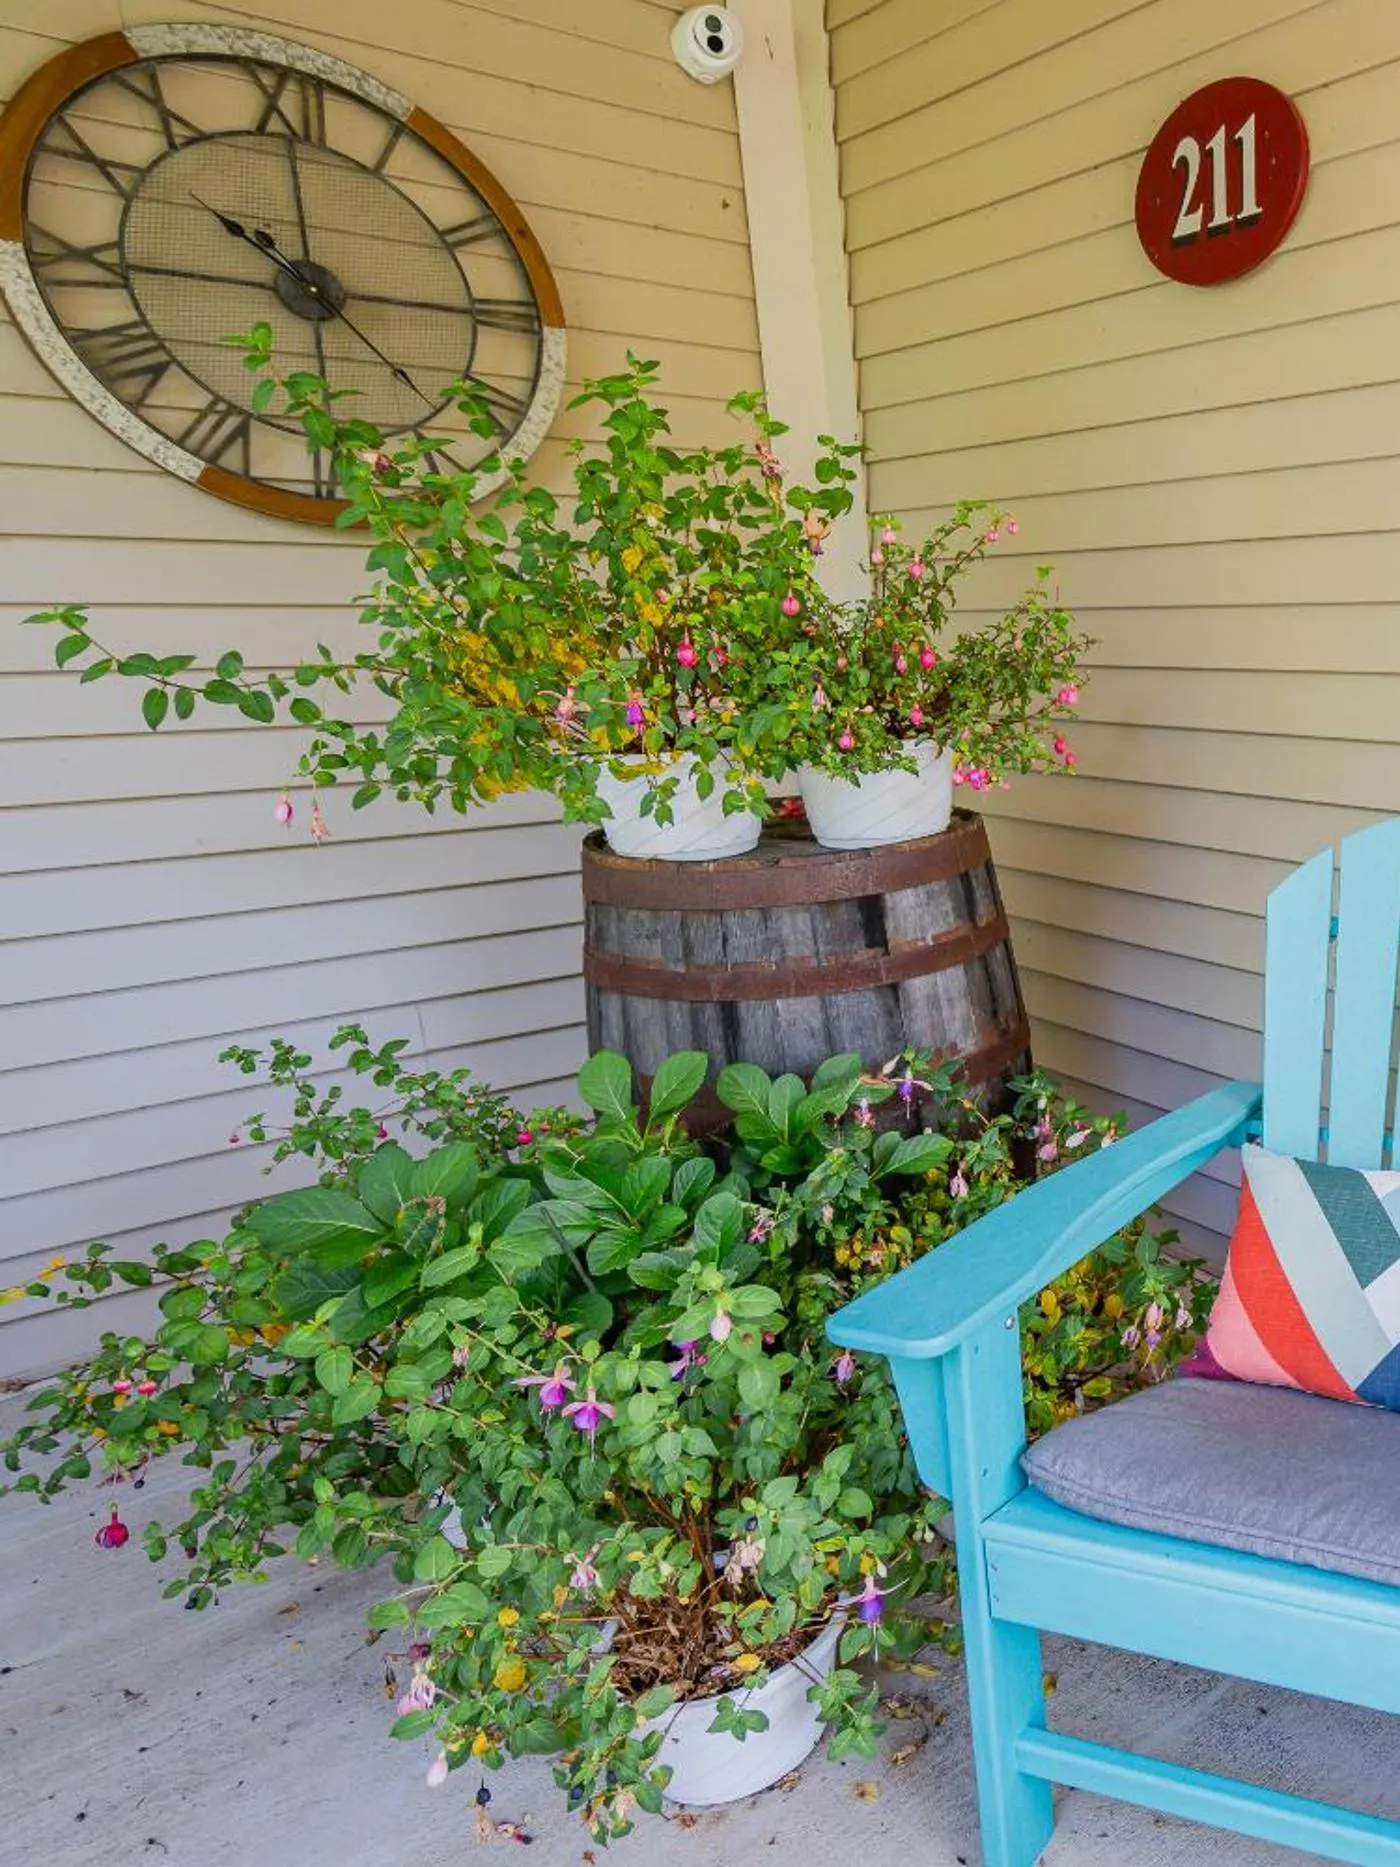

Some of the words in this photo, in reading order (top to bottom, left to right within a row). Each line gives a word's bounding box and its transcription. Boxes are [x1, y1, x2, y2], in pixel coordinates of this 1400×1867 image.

[241, 63, 327, 148] XII
[35, 115, 148, 202] X
[377, 122, 406, 175] I
[1172, 112, 1263, 239] 211
[28, 222, 130, 289] IX
[440, 214, 502, 250] II
[471, 297, 541, 336] III
[70, 320, 173, 411] VIII
[178, 400, 251, 476] VII
